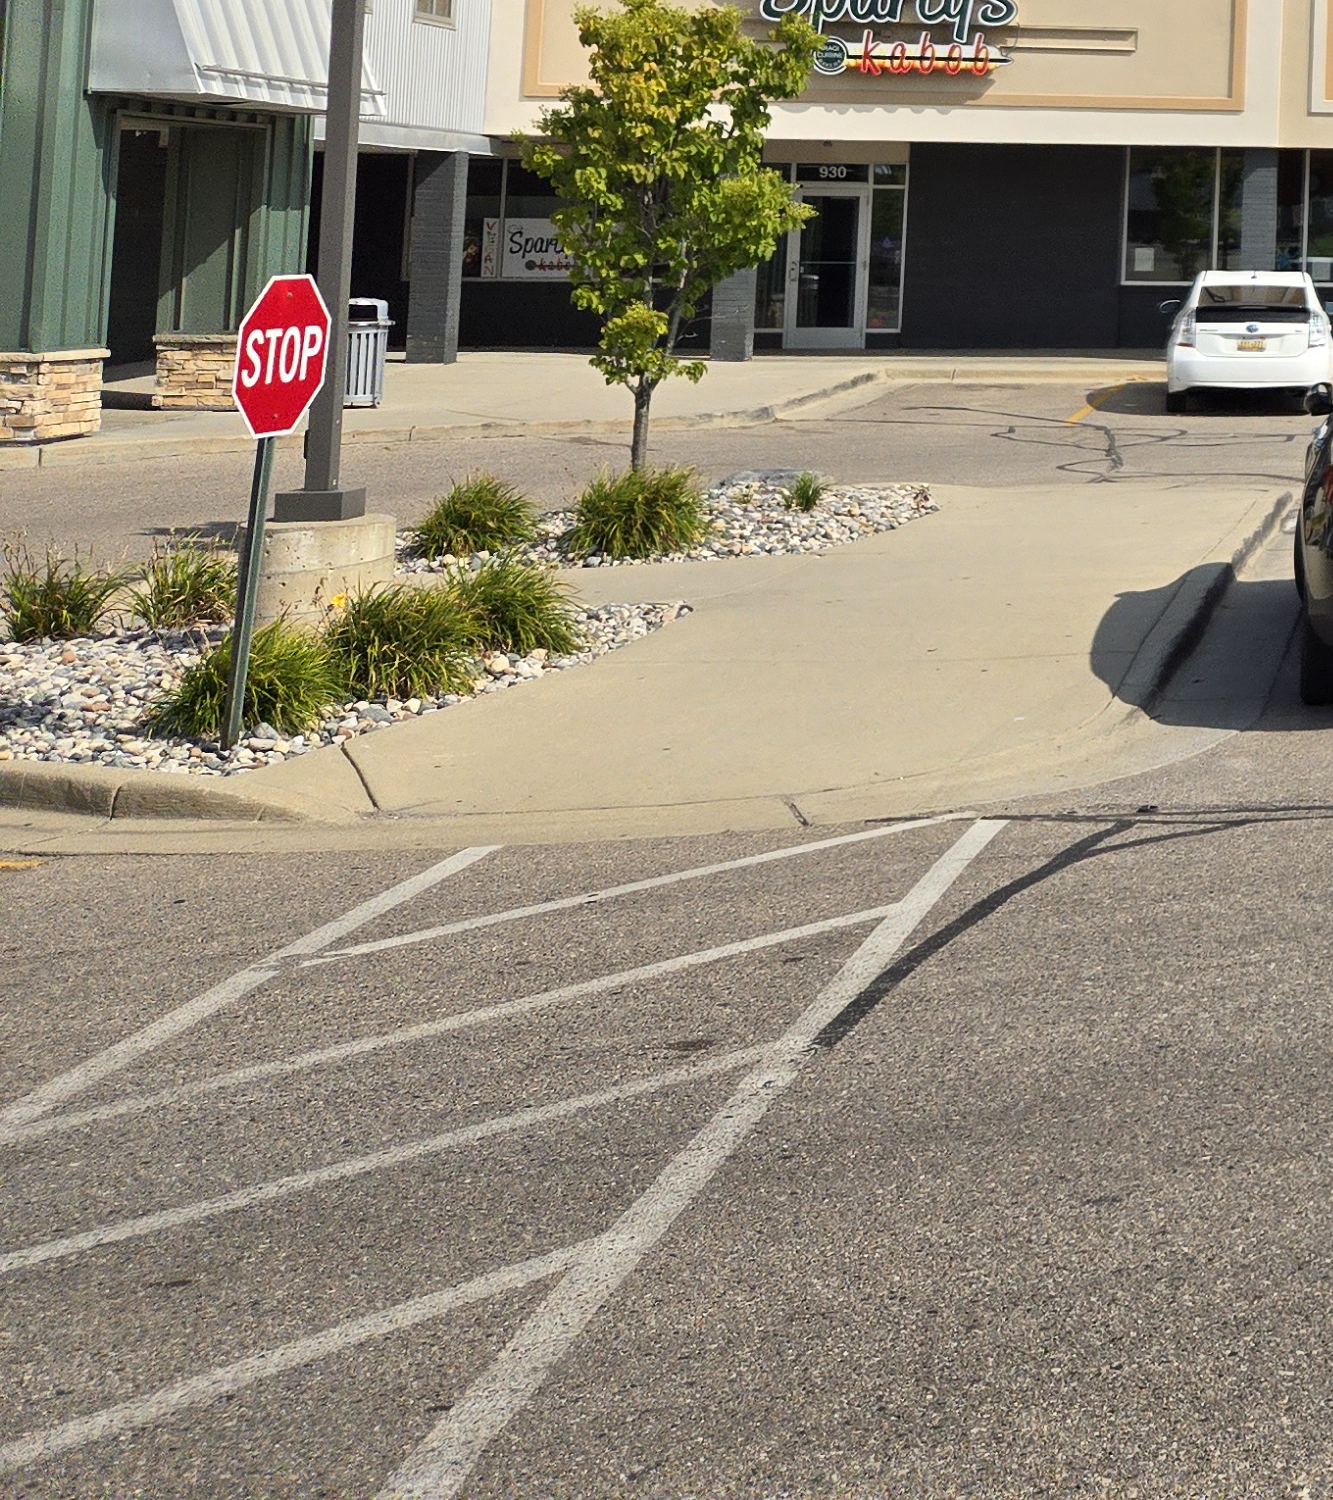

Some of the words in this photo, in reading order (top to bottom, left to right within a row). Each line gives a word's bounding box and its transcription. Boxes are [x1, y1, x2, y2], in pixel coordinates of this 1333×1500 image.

[859, 29, 990, 76] kabob
[819, 165, 847, 178] 930
[509, 231, 569, 259] Spart
[241, 325, 323, 388] STOP
